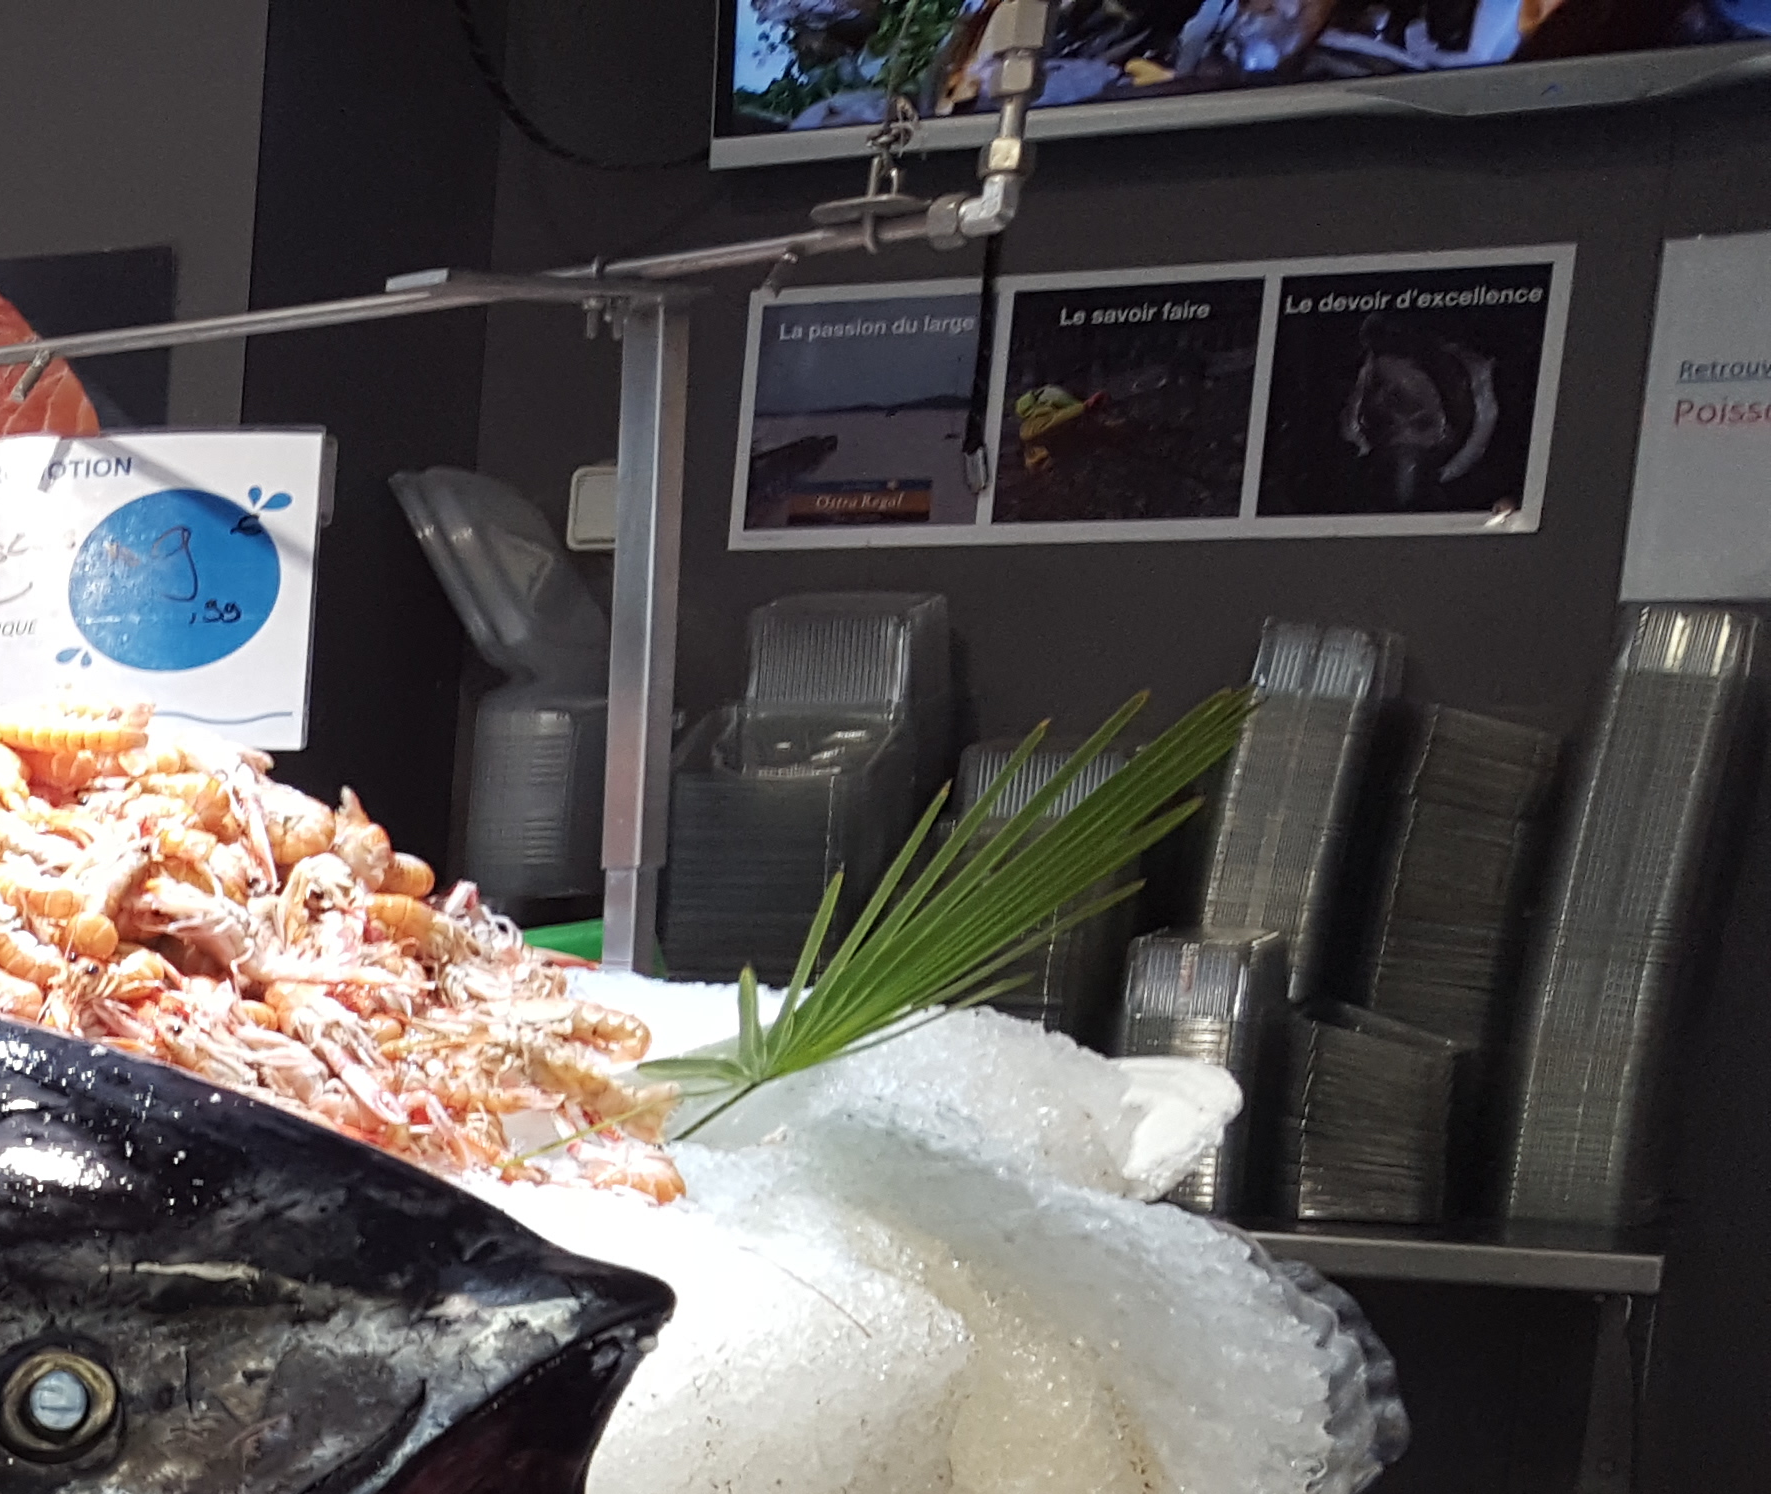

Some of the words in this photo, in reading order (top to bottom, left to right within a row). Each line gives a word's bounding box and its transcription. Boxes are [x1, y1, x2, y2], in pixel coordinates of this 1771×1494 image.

[1060, 306, 1087, 327] Le
[1091, 302, 1158, 324] savoir
[1163, 300, 1211, 321] faire
[1284, 294, 1312, 315] Le
[1318, 291, 1388, 313] devoir
[1396, 285, 1545, 310] d'excellence
[779, 323, 804, 341] La
[808, 317, 887, 343] passion
[893, 315, 918, 335] du
[924, 313, 976, 338] large
